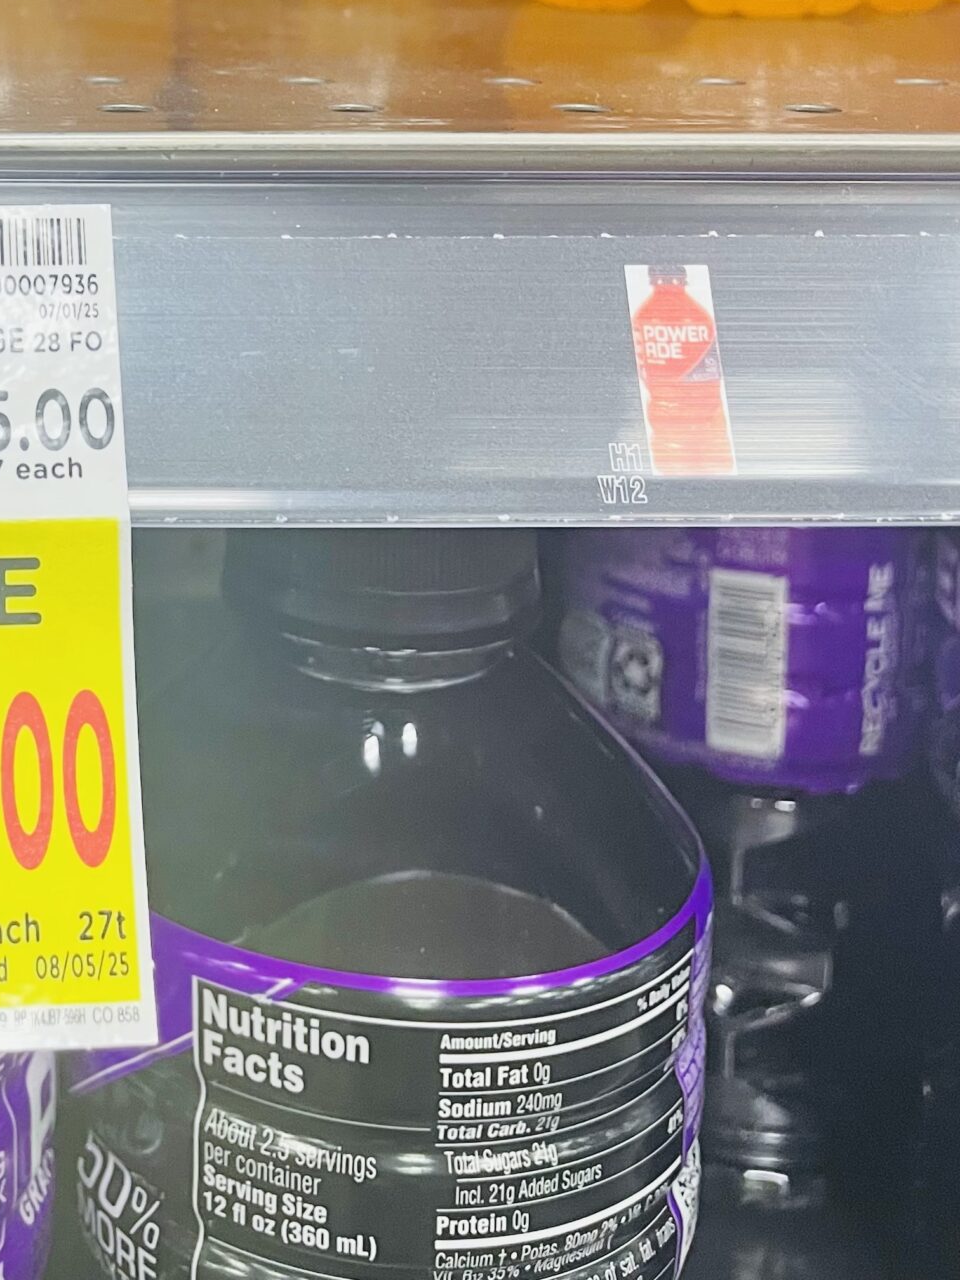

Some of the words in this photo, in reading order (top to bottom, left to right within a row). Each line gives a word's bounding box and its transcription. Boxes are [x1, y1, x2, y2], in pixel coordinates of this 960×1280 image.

[39, 303, 100, 320] 07/01/25
[34, 332, 60, 353] 28
[71, 331, 103, 351] FO
[643, 324, 709, 342] POWER
[646, 342, 683, 359] ADE
[16, 458, 83, 480] each
[608, 443, 643, 472] H1
[597, 475, 648, 504] W12
[78, 911, 127, 942] 27t
[36, 952, 130, 981] 08/05/25
[92, 1006, 113, 1023] CO
[202, 988, 370, 1064] Nutrition
[440, 1028, 556, 1050] Amount/Serving
[203, 1029, 305, 1093] Facts
[441, 1066, 491, 1089] Total
[497, 1065, 529, 1086] Fat
[533, 1062, 550, 1084] 0g
[438, 1096, 512, 1118] Sodium
[516, 1092, 563, 1114] 240mg
[437, 1123, 485, 1141] Total
[488, 1119, 532, 1138] Carb.
[535, 1115, 560, 1132] 21g
[204, 1107, 257, 1151] About
[262, 1127, 291, 1161] 2.5
[295, 1146, 377, 1183] servings
[203, 1141, 231, 1169] per
[235, 1152, 322, 1195] container
[444, 1152, 480, 1175] Total
[483, 1146, 532, 1172] Sugars
[203, 1163, 278, 1216] Serving
[282, 1192, 327, 1223] Size
[455, 1185, 485, 1206] Incl.
[488, 1183, 515, 1205] 21g
[518, 1175, 559, 1199] Added
[561, 1162, 602, 1190] Sugars
[203, 1191, 227, 1218] 12
[232, 1201, 246, 1225] fl
[252, 1214, 276, 1236] oz
[281, 1217, 330, 1251] (360
[336, 1234, 378, 1261] mL)
[436, 1215, 507, 1235] Protein
[512, 1211, 530, 1232] 0g
[435, 1251, 494, 1269] Calcium
[520, 1242, 559, 1262] Potas.
